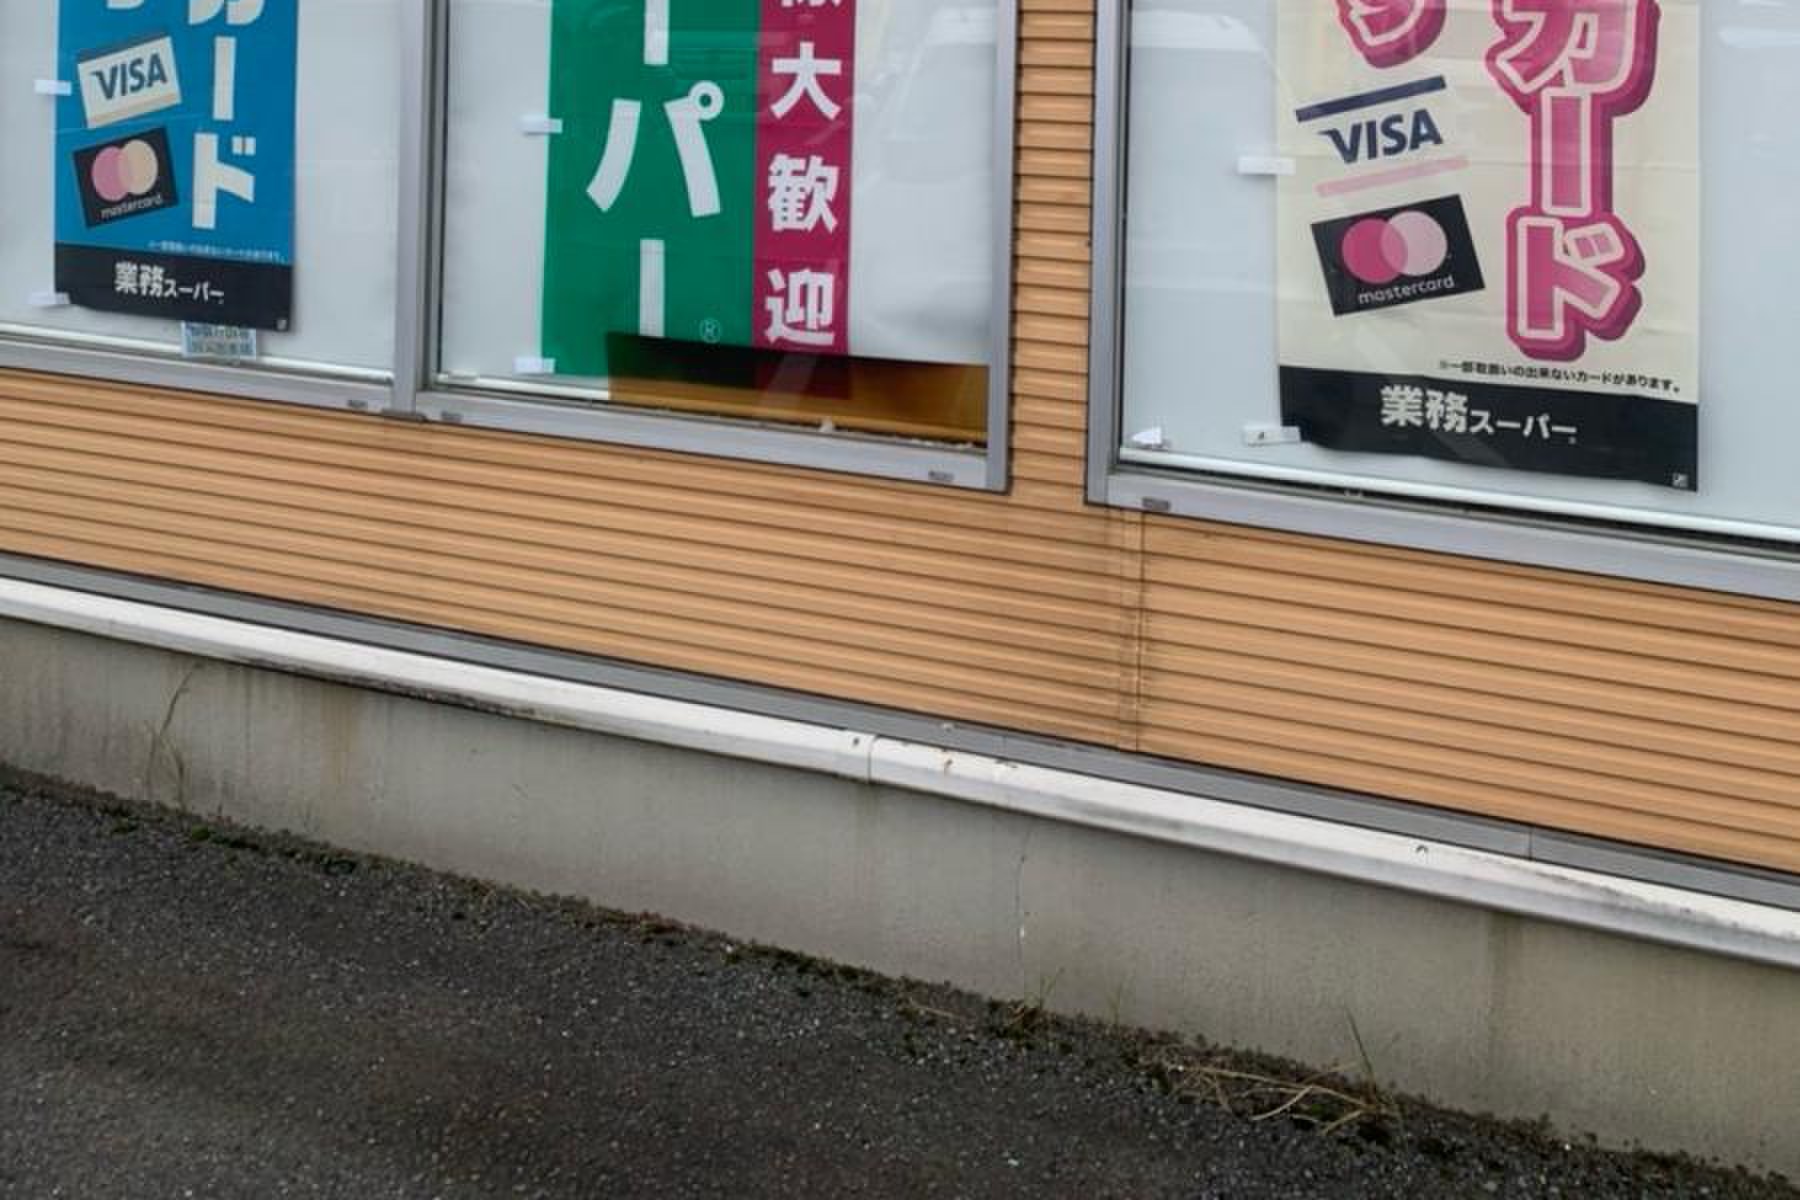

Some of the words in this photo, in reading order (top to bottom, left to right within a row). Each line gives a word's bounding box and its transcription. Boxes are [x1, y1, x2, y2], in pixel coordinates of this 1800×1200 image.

[91, 52, 168, 101] VISA
[1319, 108, 1444, 164] VISA
[100, 193, 164, 220] mastercard
[114, 261, 225, 301] 業務スーパー
[1357, 273, 1456, 305] mastercard
[1379, 384, 1578, 439] 業務スーパー
